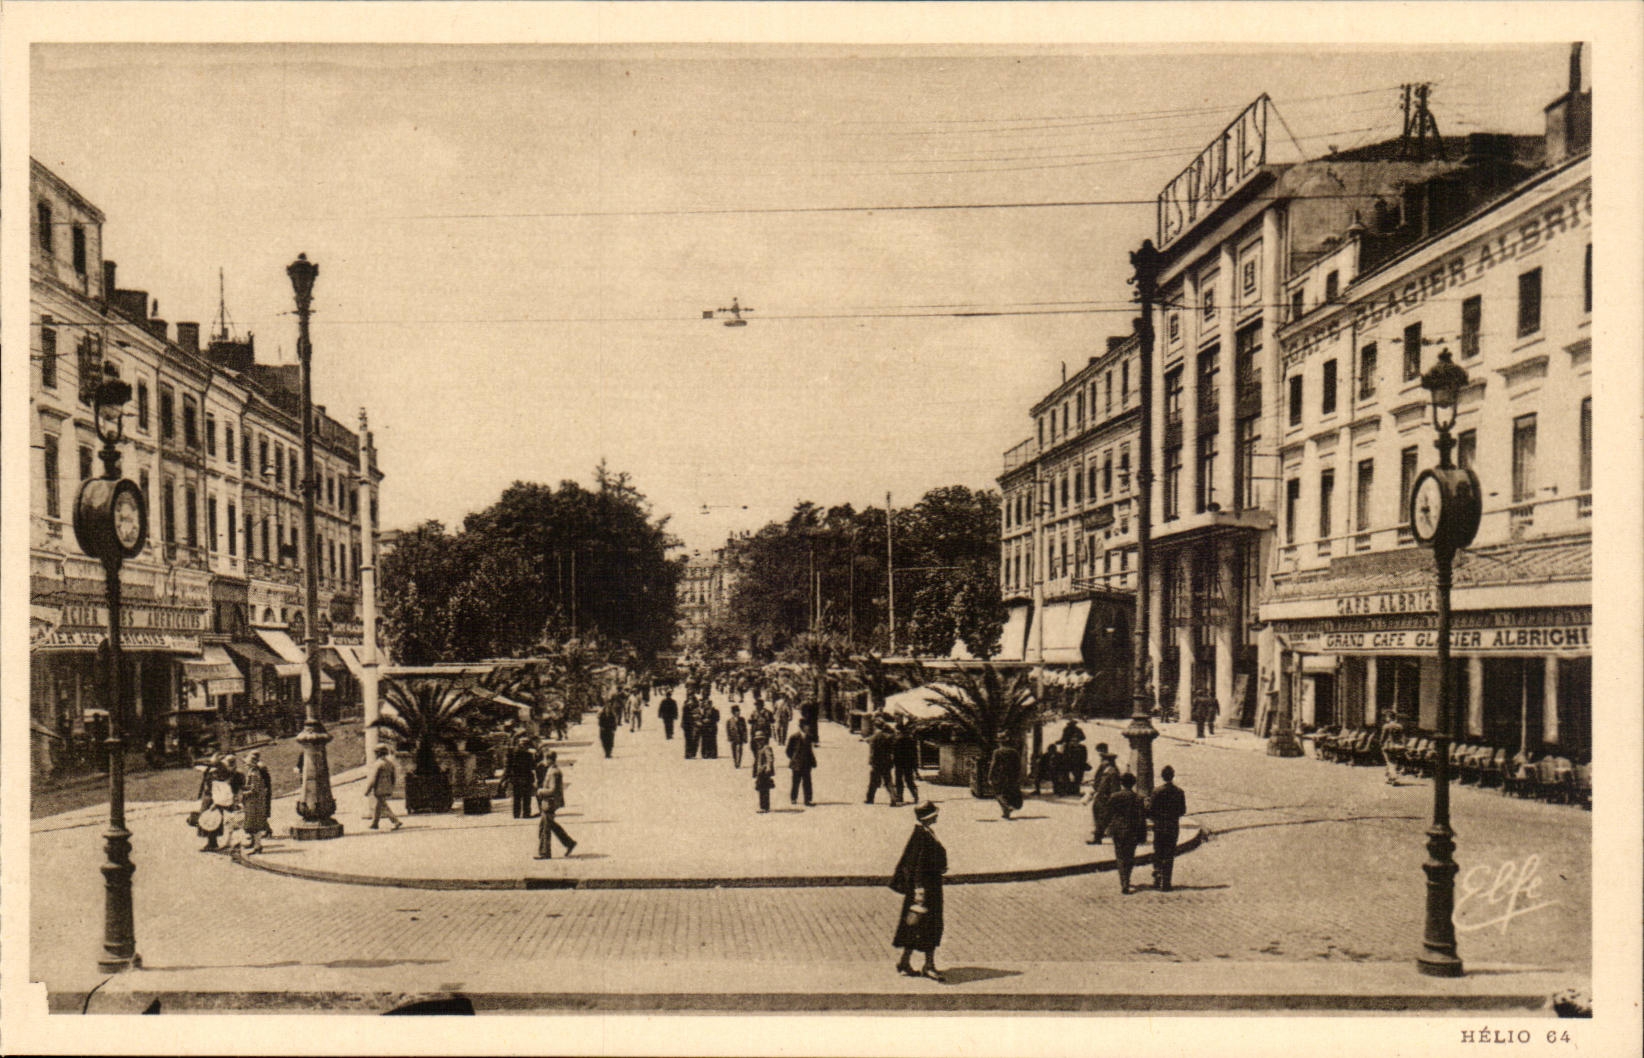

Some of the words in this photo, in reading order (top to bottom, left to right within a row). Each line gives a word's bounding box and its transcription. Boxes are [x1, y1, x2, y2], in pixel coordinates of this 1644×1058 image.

[1326, 633, 1365, 648] GRAND
[1373, 631, 1406, 648] CAFE
[1415, 630, 1482, 648] GLIER
[1492, 626, 1589, 647] ALBRIGHI
